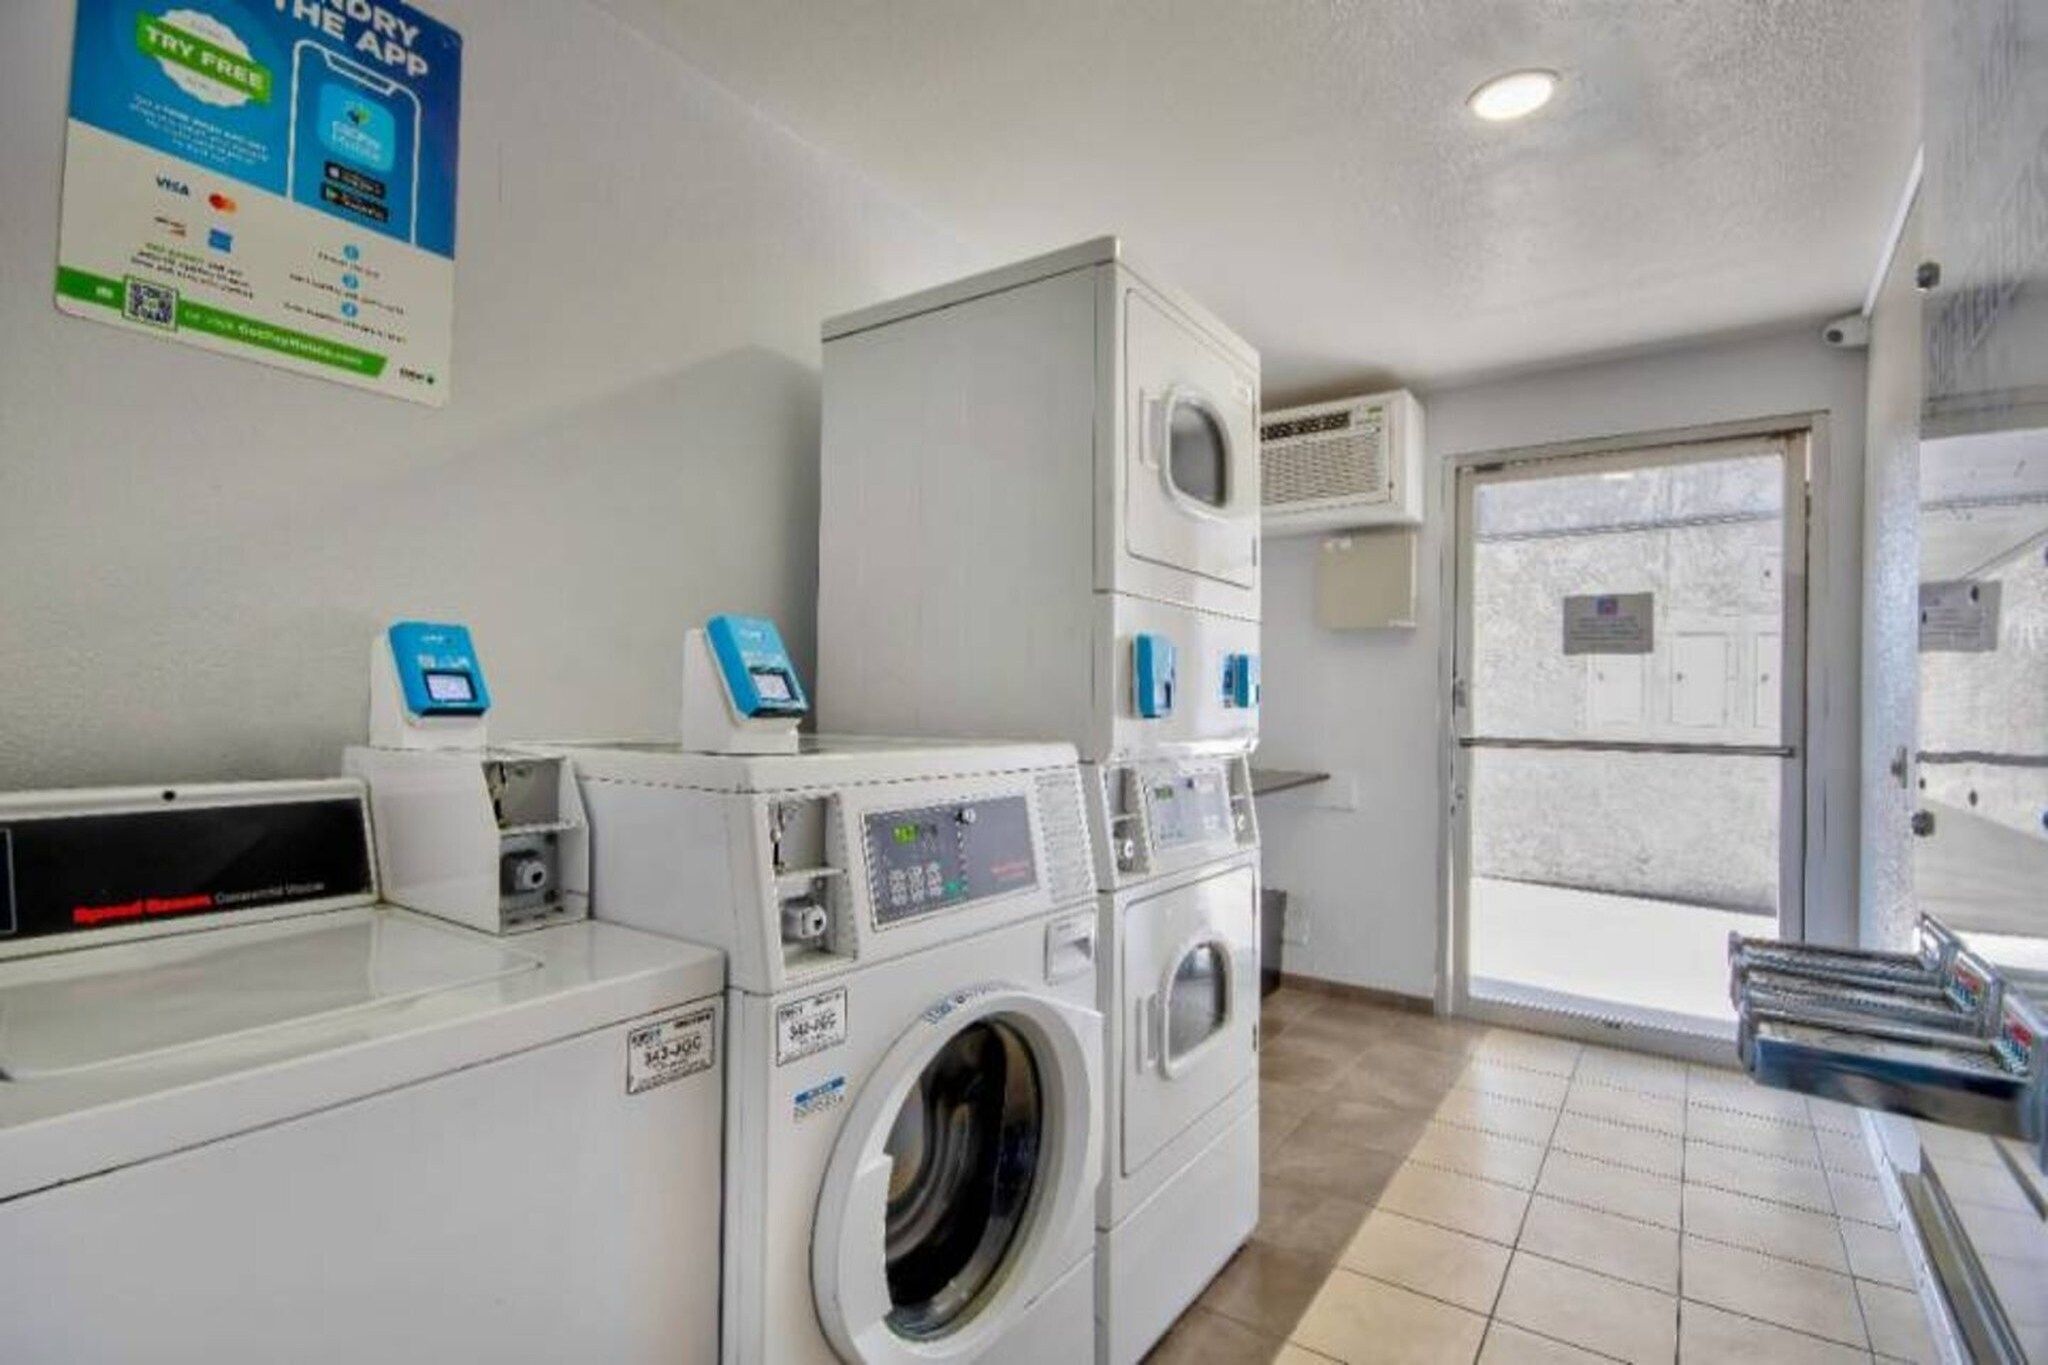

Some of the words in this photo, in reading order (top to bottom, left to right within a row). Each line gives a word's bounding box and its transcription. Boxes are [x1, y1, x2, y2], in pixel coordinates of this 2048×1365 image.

[145, 24, 194, 58] TRY
[201, 50, 264, 90] FREE
[355, 29, 429, 77] APP
[154, 176, 190, 196] VISA
